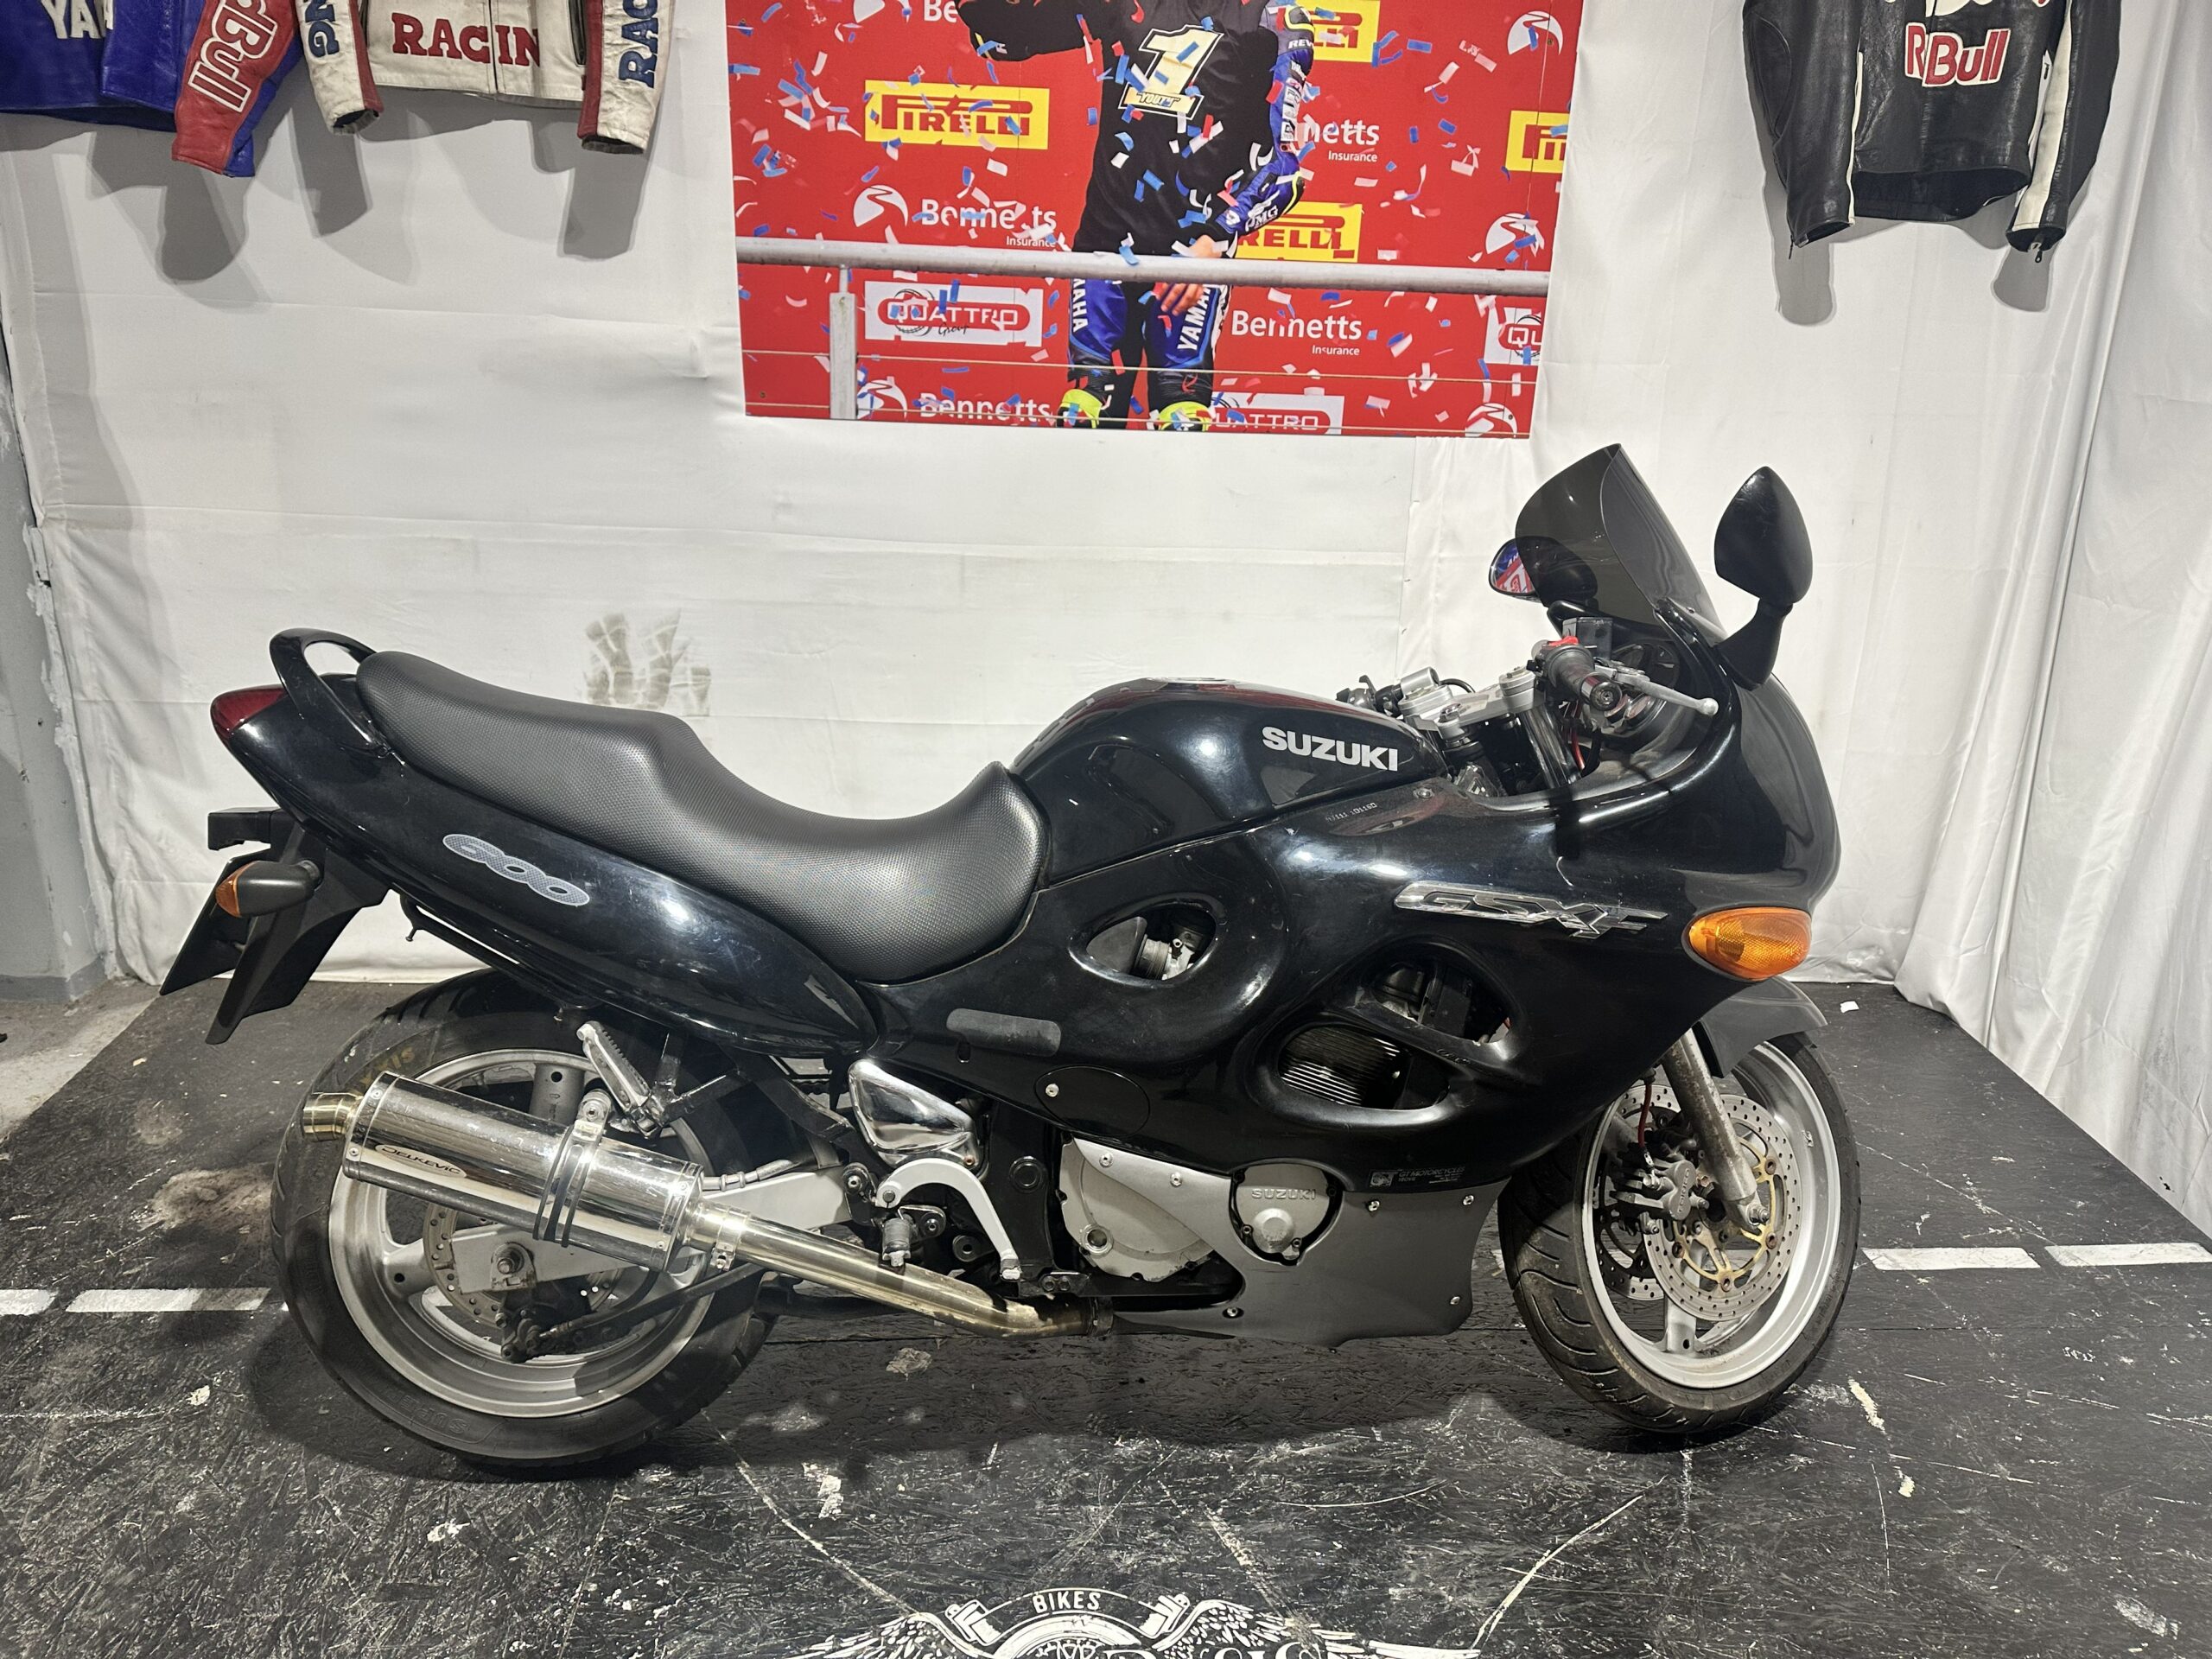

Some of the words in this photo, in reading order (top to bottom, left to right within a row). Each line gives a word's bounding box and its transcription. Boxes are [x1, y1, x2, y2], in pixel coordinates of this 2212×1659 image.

[880, 93, 1033, 136] PIRELLI
[1328, 149, 1378, 162] Insurance
[921, 199, 1057, 231] Bennets
[938, 321, 970, 335] Group
[1231, 310, 1362, 340] Bennetts
[1312, 345, 1361, 356] Insurance
[1262, 726, 1398, 772] SUZUKI
[442, 833, 590, 906] 600
[381, 1145, 461, 1174] DELKEVIC
[1251, 1188, 1318, 1200] SUZUKI
[1032, 1591, 1102, 1614] BIKES
